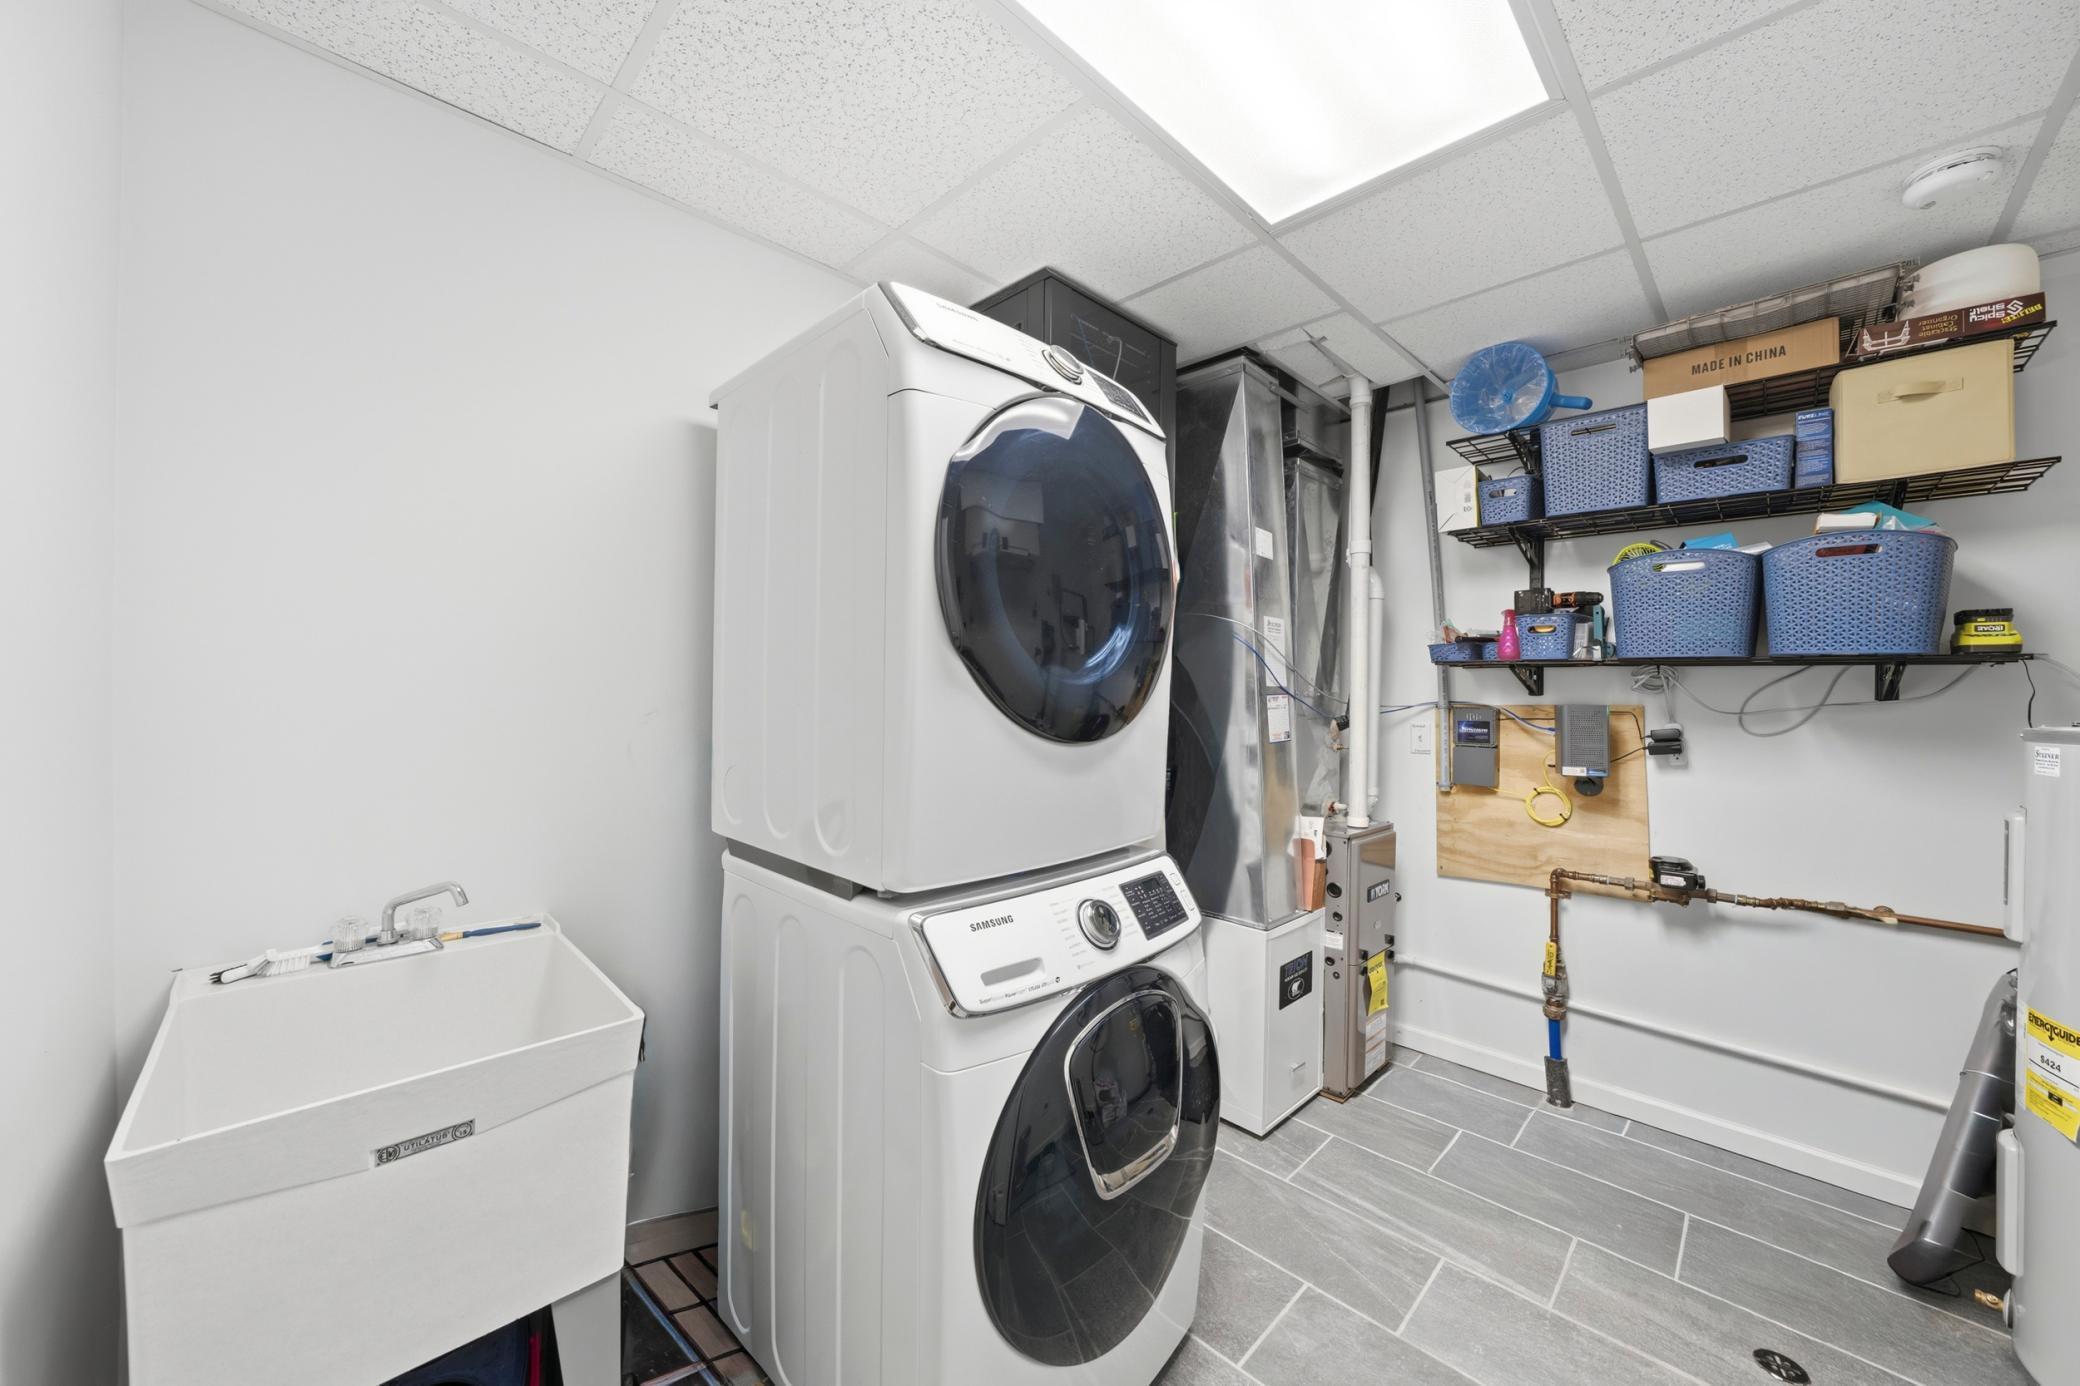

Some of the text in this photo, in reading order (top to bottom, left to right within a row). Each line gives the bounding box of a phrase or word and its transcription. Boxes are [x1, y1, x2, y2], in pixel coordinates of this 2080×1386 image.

[1918, 314, 1958, 326] Organizer
[1922, 320, 1954, 331] Cabinet
[1691, 345, 1786, 375] MADE IN CHINA
[969, 914, 1014, 932] SAMSUNG
[2040, 1055, 2062, 1073] $424
